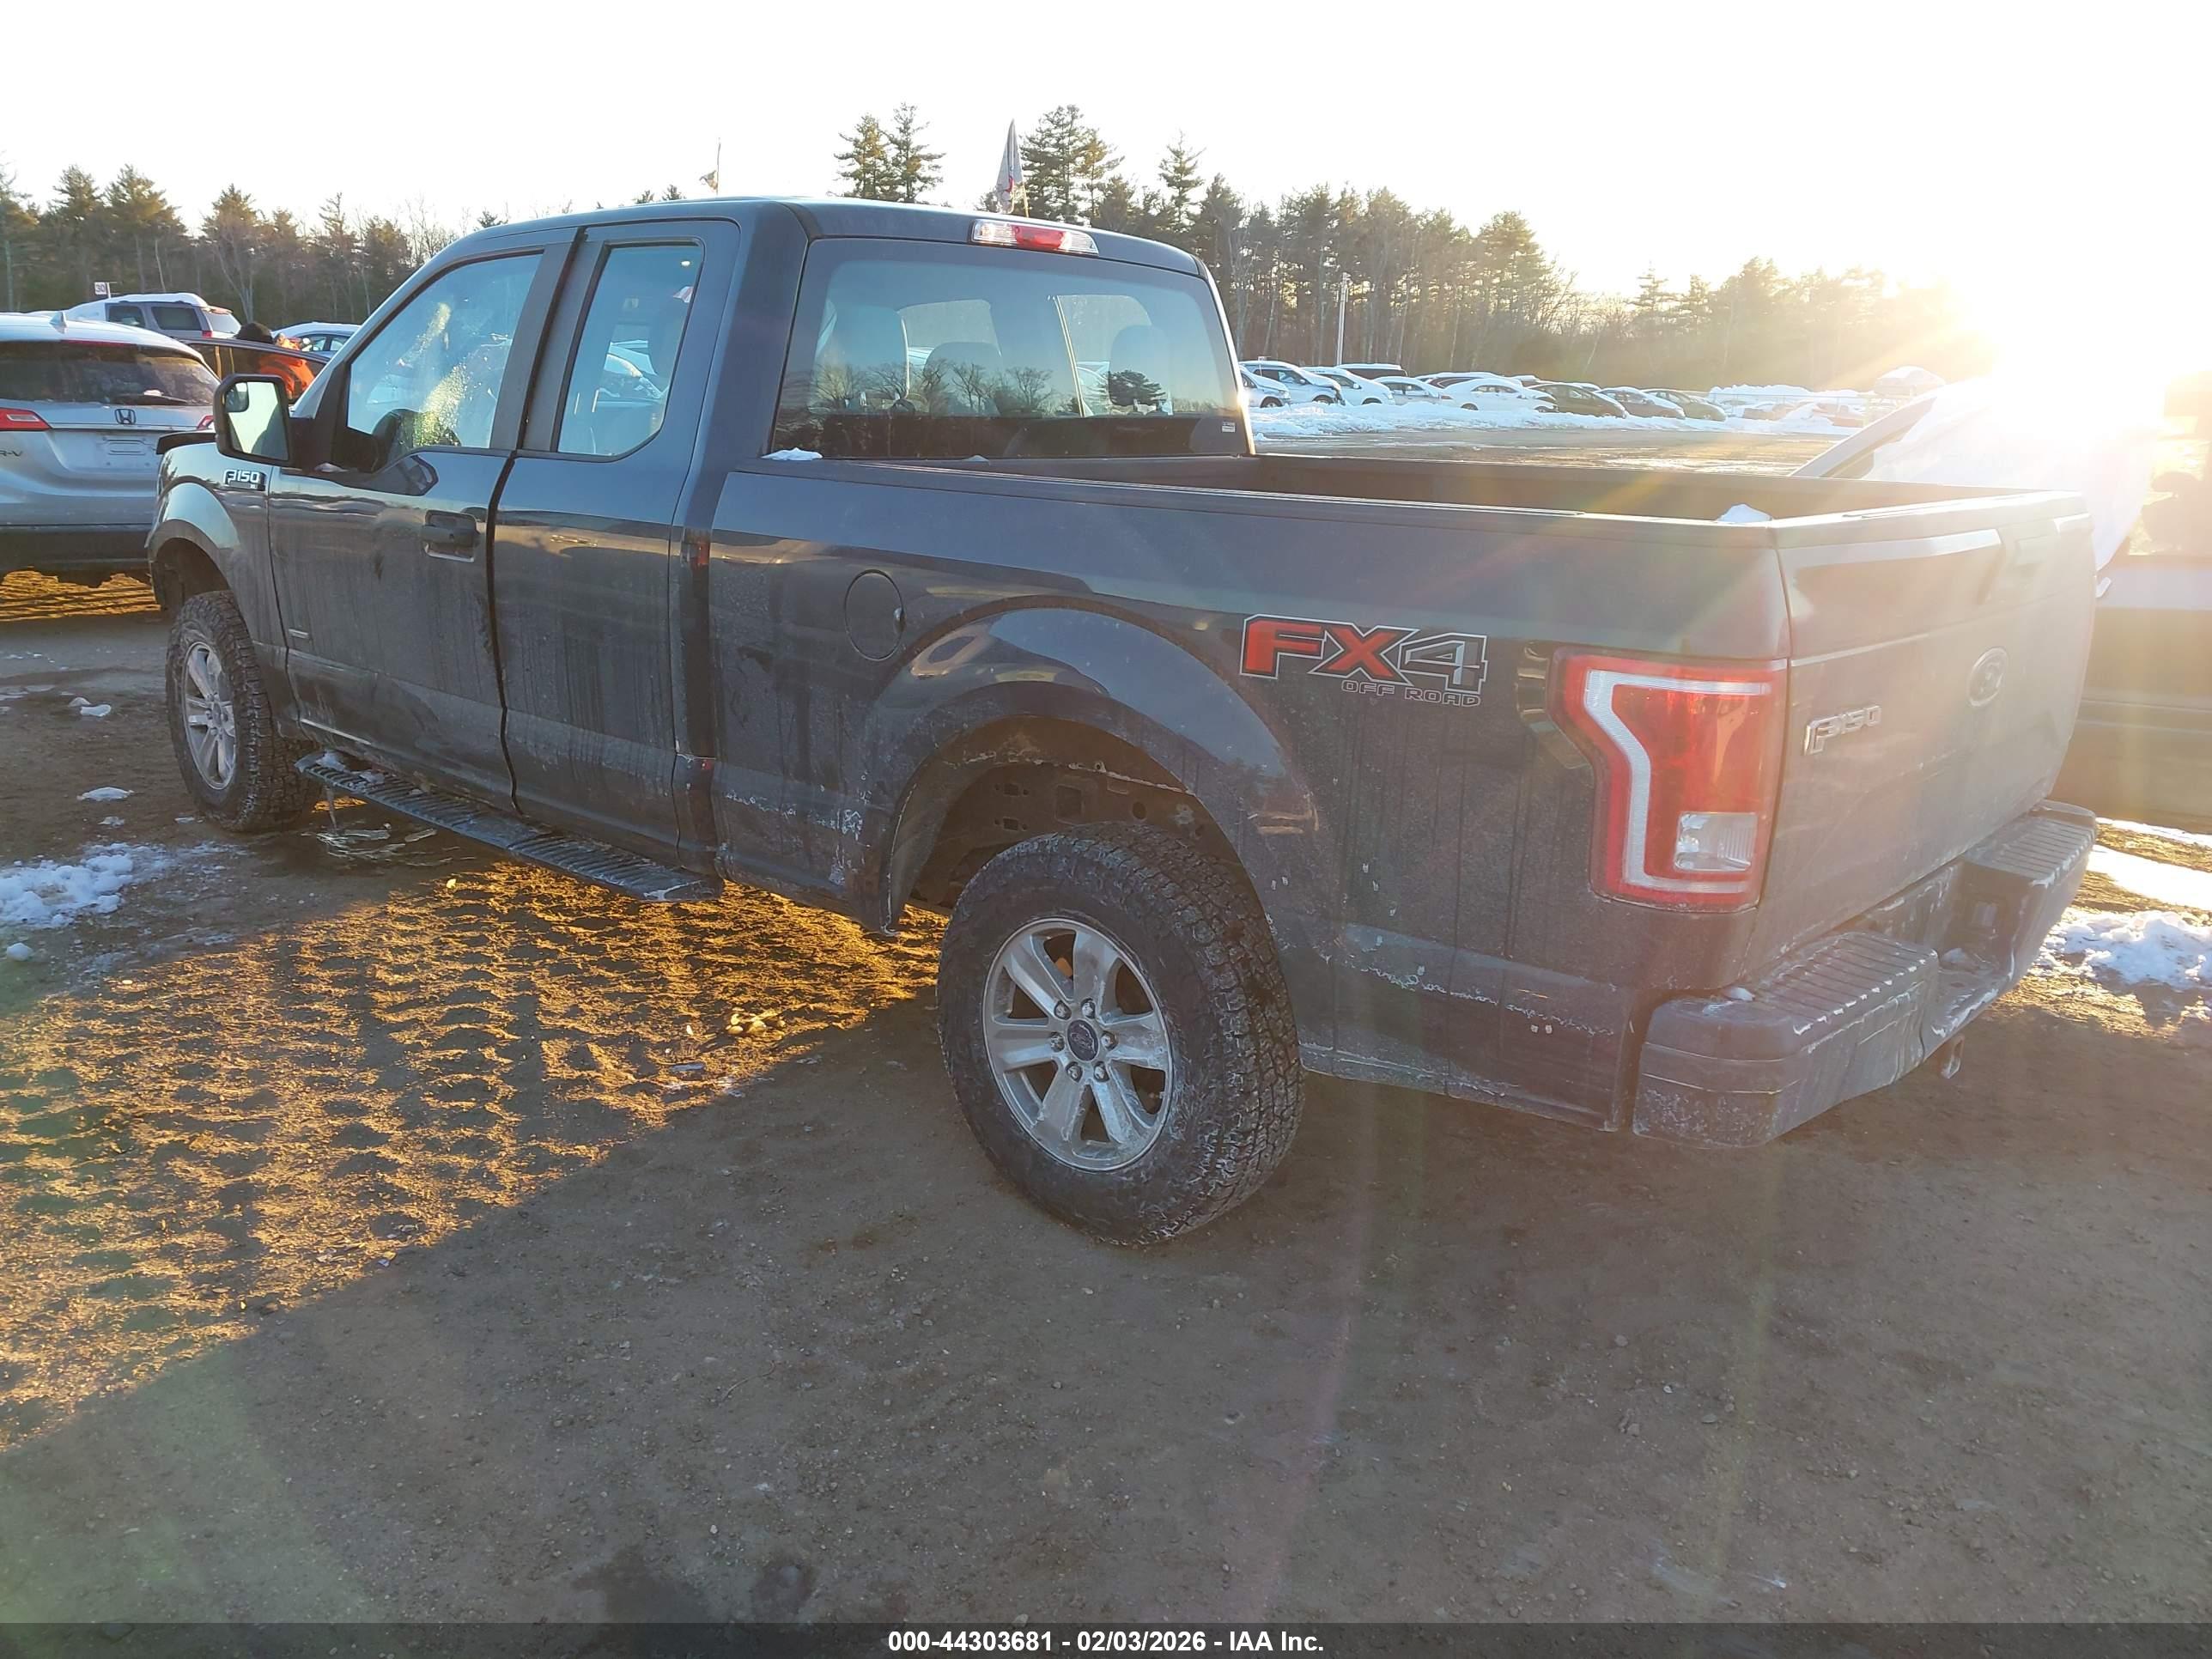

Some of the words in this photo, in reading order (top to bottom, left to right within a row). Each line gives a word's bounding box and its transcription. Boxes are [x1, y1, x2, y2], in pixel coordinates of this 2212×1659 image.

[223, 469, 260, 485] F150
[1239, 613, 1489, 695] FX4
[1341, 679, 1395, 696] OFF
[1404, 686, 1481, 708] ROAD
[1803, 705, 1882, 756] F150
